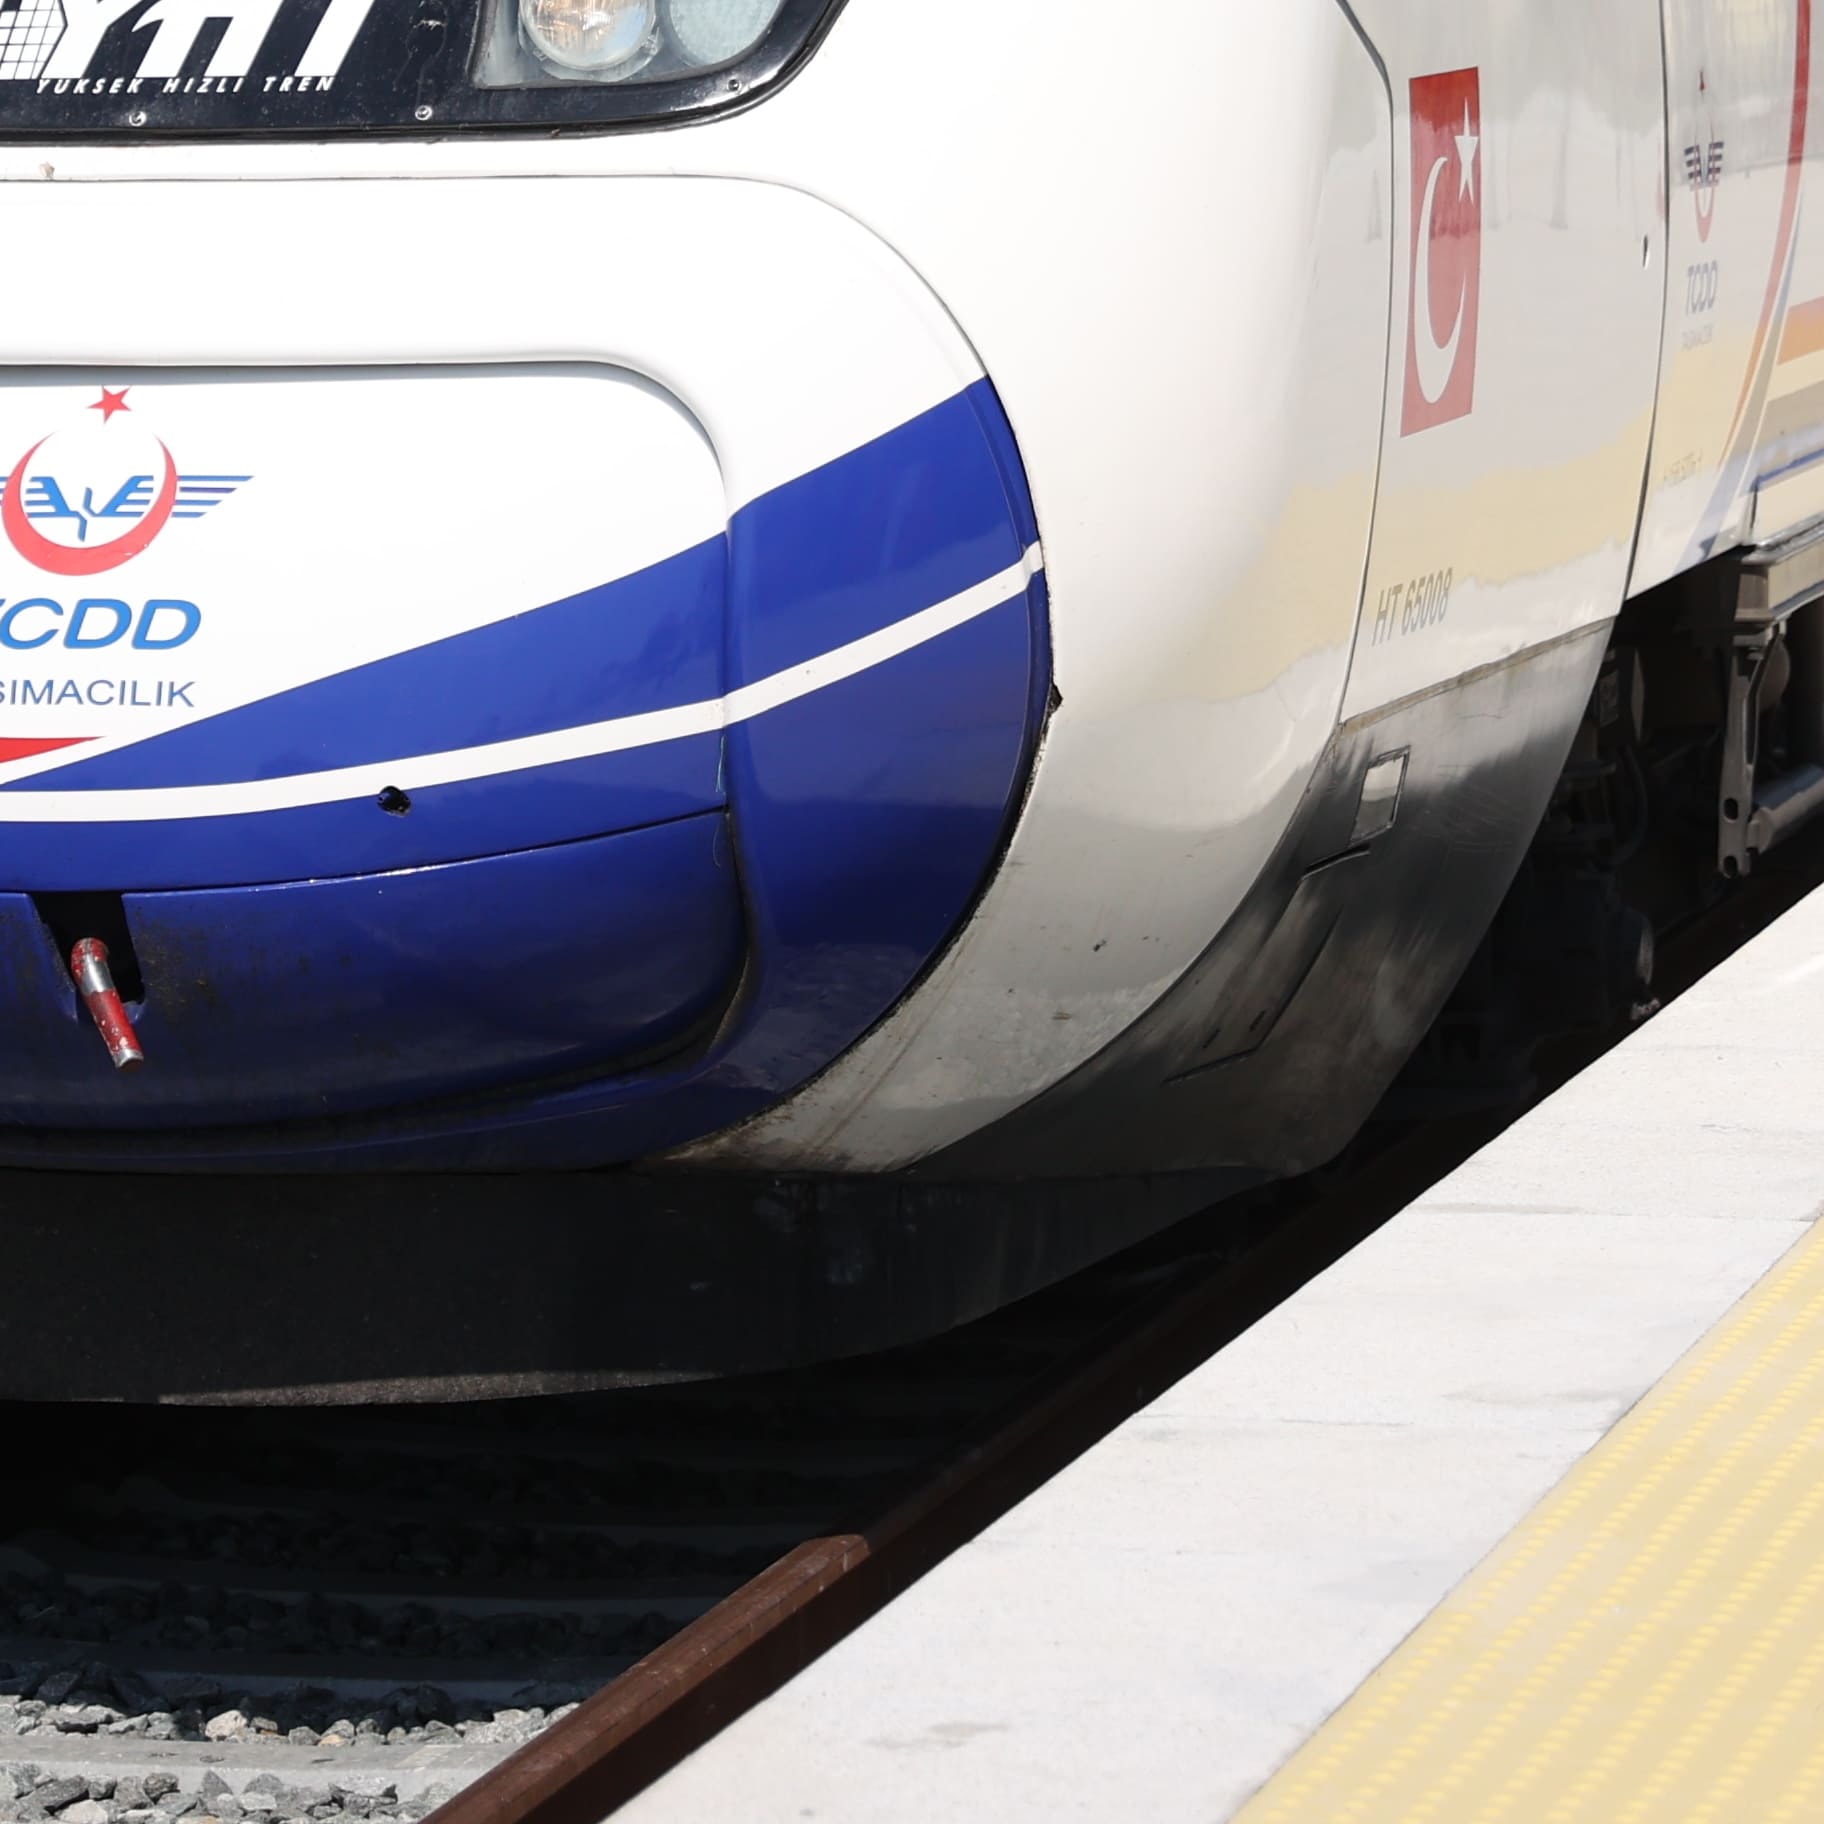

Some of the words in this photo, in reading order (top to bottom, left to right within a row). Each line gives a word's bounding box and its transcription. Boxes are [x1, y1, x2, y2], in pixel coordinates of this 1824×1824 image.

[162, 77, 244, 93] HIZLI
[263, 76, 336, 92] TREN
[1371, 583, 1403, 647] HT
[1401, 567, 1453, 636] 65008
